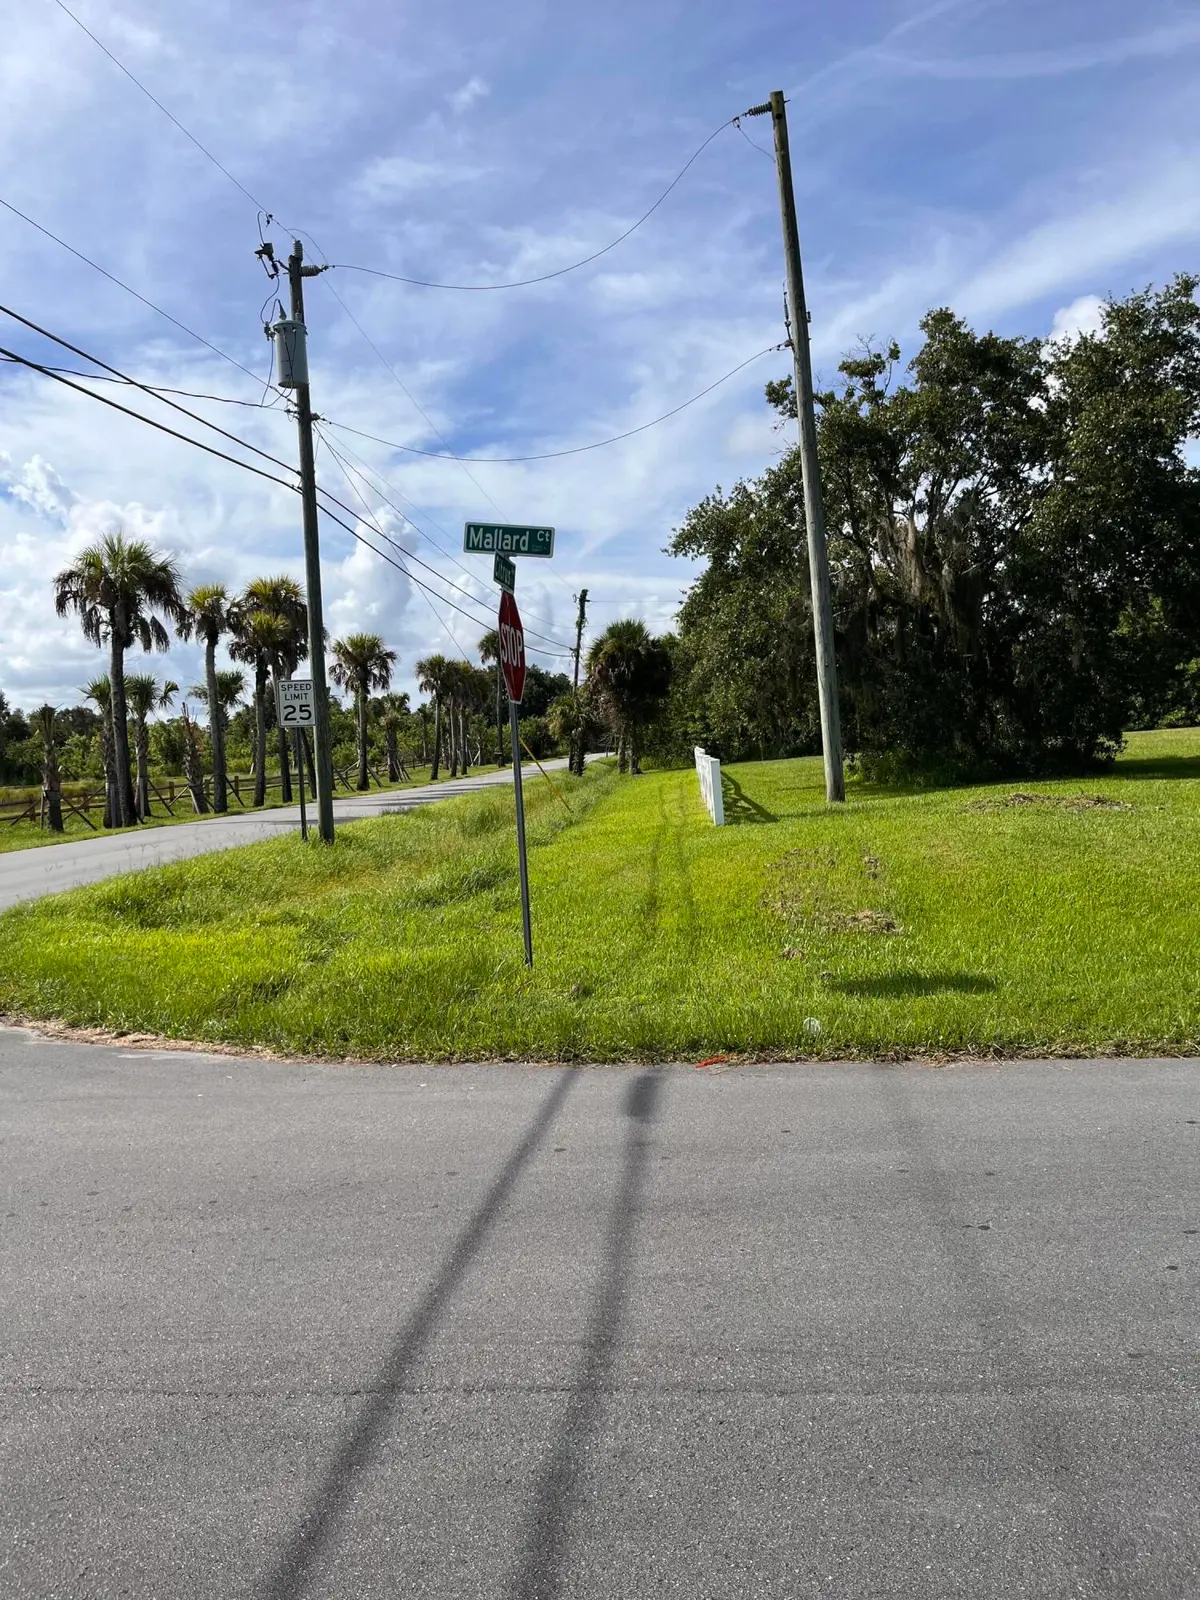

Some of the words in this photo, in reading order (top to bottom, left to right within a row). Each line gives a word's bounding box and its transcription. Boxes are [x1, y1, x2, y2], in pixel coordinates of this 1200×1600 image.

[469, 527, 529, 551] Mallard
[537, 530, 550, 542] Ct
[501, 622, 523, 668] STOP
[281, 683, 312, 691] SPEED
[283, 704, 312, 721] 25
